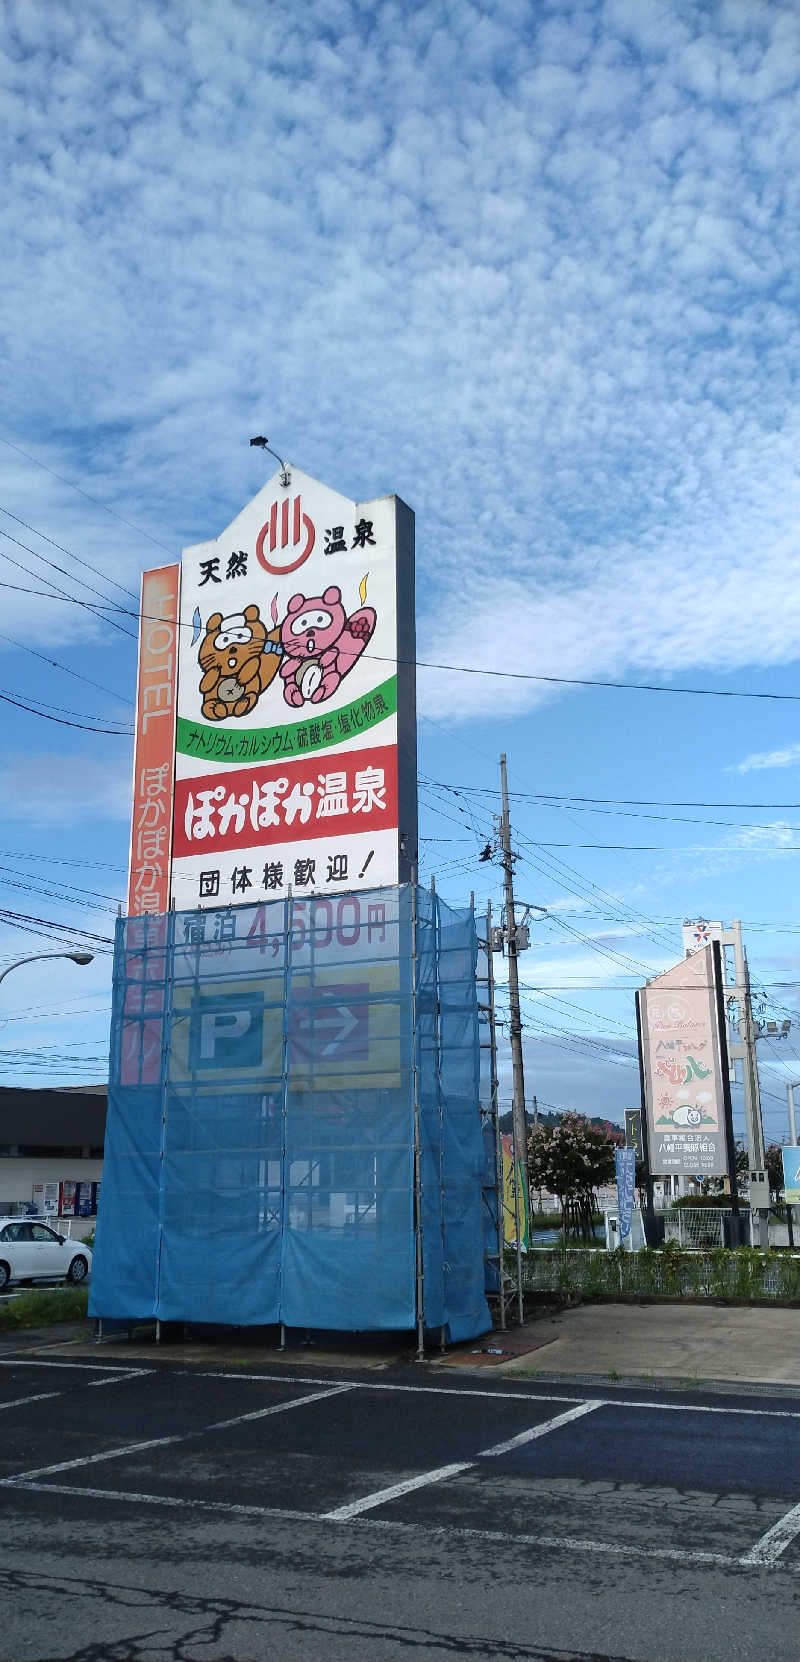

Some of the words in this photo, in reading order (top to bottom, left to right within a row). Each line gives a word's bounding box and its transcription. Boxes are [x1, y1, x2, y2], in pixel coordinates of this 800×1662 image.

[323, 518, 377, 556] 温泉
[198, 551, 249, 587] 天然
[142, 592, 176, 736] HOTEL
[184, 765, 387, 841] ぽかぽか温泉
[184, 909, 237, 945] 宿泊
[202, 1011, 251, 1059] P
